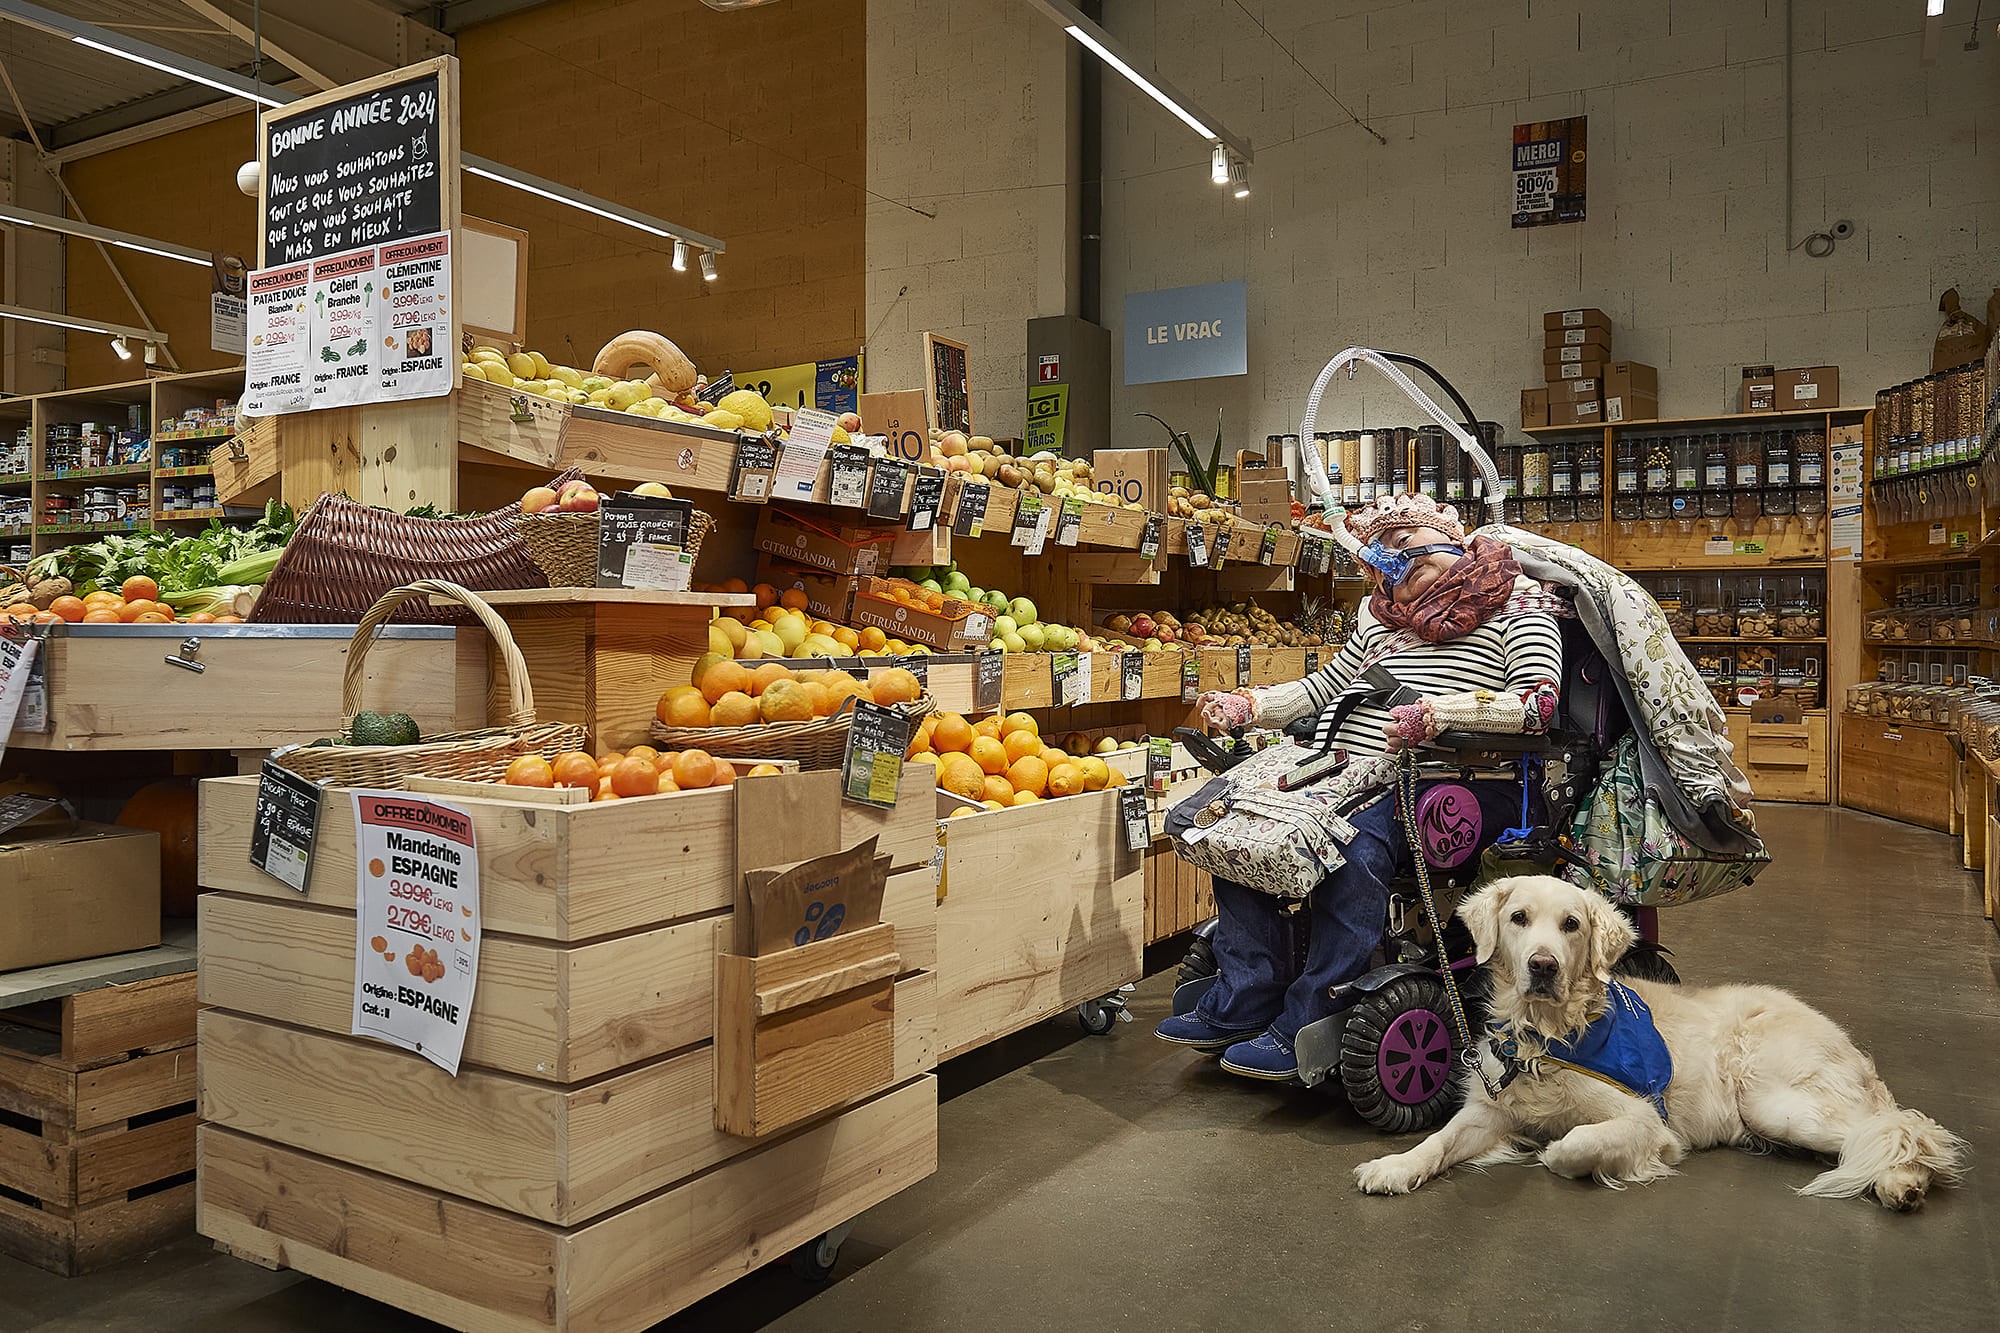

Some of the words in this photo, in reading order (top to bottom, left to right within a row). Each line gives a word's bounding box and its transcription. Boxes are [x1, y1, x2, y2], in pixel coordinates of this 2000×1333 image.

[272, 119, 325, 158] BONNE
[330, 93, 392, 135] ANNÉE
[397, 90, 436, 125] 2024
[1517, 142, 1560, 162] MERCI
[304, 170, 329, 188] VOUS
[1517, 176, 1553, 194] 90%
[269, 203, 292, 222] TOUT
[296, 197, 308, 214] CE
[312, 189, 333, 210] QUE
[338, 184, 363, 202] VOUS
[268, 226, 287, 248] QUE
[294, 218, 317, 237] L'ON
[322, 208, 347, 229] VOUS
[324, 232, 341, 248] EN
[393, 276, 434, 293] ESPAGNE
[254, 292, 281, 306] PATATE
[282, 286, 307, 301] DOUCE
[328, 294, 360, 308] Branche
[268, 303, 293, 315] Blanche
[1148, 326, 1168, 344] LE
[1174, 320, 1221, 341] VRAC
[336, 364, 368, 380] FRANCE
[401, 357, 442, 372] ESPAGNE
[271, 373, 301, 386] FRANCE
[1029, 399, 1059, 417] ICI
[888, 419, 899, 428] La
[1028, 433, 1055, 448] VRACS
[762, 539, 836, 568] CITRUSLANDIA
[860, 612, 936, 643] CITRUSLANDIA
[374, 804, 415, 820] OFFRE
[416, 806, 430, 824] DU
[431, 812, 467, 836] MOMENT
[386, 832, 461, 866] Mandarine
[392, 855, 458, 888] ESPAGNE
[803, 876, 839, 894] biocoop
[398, 985, 459, 1025] ESPAGNE
